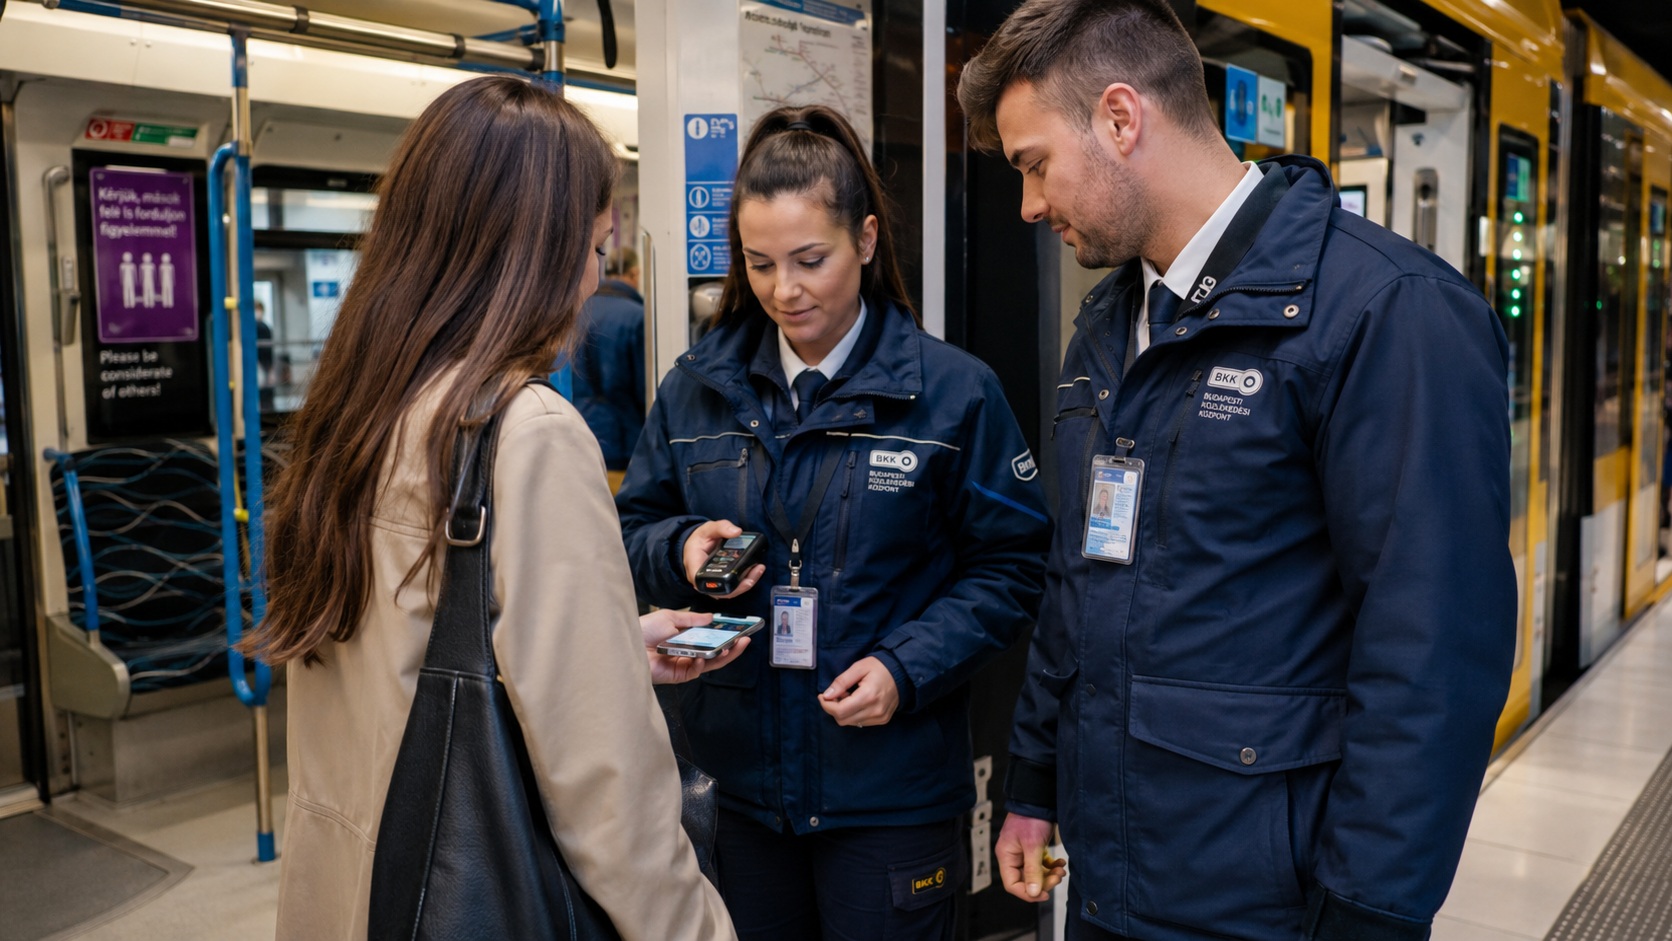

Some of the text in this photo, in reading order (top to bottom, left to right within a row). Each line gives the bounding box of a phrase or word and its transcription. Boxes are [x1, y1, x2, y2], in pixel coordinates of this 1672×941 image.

[100, 348, 158, 364] Please be
[101, 366, 173, 382] considerate
[1215, 372, 1238, 384] BKK
[102, 382, 161, 399] of others!
[876, 454, 896, 464] BKK
